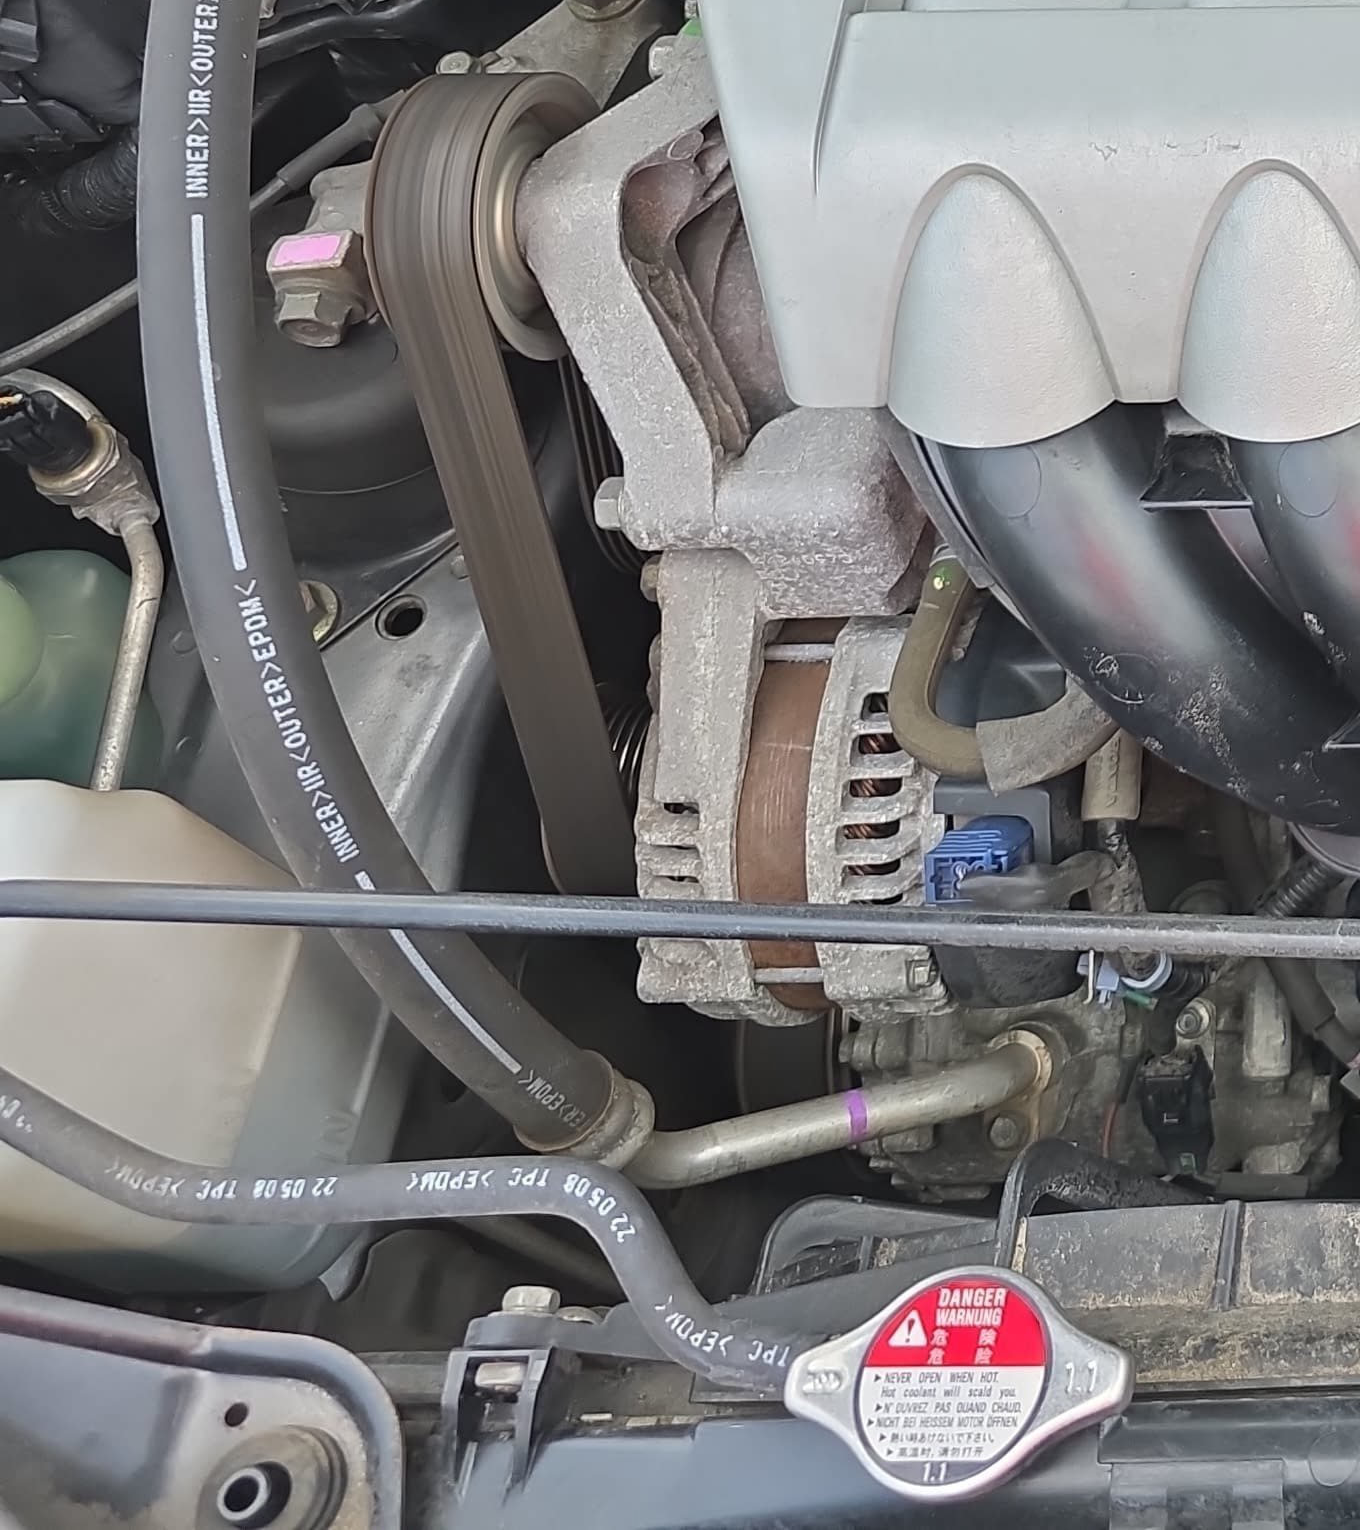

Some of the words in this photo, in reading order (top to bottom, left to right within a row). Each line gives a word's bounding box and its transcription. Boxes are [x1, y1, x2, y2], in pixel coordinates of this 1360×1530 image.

[312, 1176, 339, 1197] 22
[508, 1167, 551, 1188] TPC
[195, 1178, 238, 1200] TPC
[610, 1213, 637, 1244] 22
[937, 1286, 1007, 1309] DANGER
[934, 1307, 1003, 1327] WARNUNG
[748, 1339, 792, 1368] TPC
[884, 1372, 912, 1384] NEVER
[918, 1372, 942, 1384] OPEN
[949, 1372, 975, 1384] WHEN
[1064, 1359, 1098, 1394] 1.1
[880, 1386, 897, 1398] Hot
[903, 1386, 937, 1398] coolant
[943, 1386, 961, 1397] will
[967, 1386, 993, 1397] scald
[933, 1402, 952, 1413] PAS
[921, 1461, 947, 1483] 1.1
